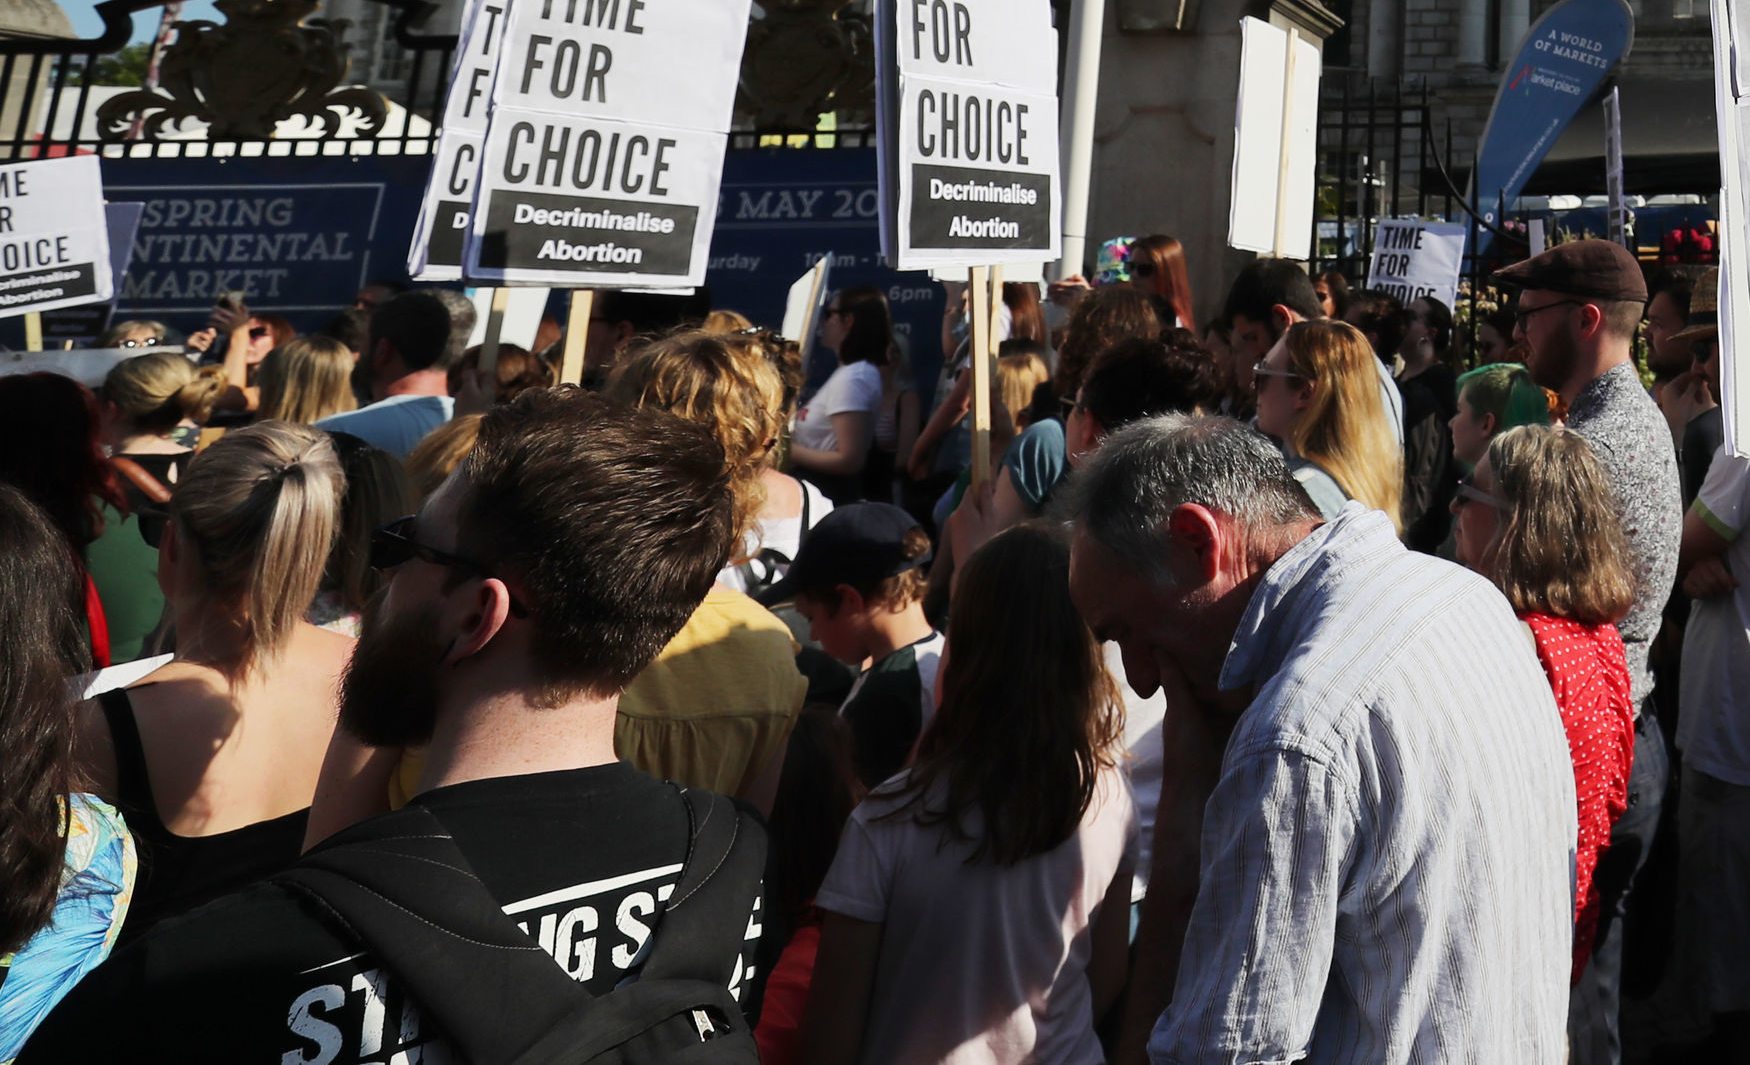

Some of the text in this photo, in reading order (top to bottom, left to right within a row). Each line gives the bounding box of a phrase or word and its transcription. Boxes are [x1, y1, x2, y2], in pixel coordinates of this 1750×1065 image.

[1534, 40, 1608, 70] OF MARKETS
[1548, 29, 1603, 53] A WORLD
[519, 34, 613, 104] FOR
[917, 89, 1029, 166] CHOICE
[503, 122, 677, 197] CHOICE
[735, 190, 823, 220] MAY
[931, 178, 1037, 205] Decriminalise
[142, 199, 294, 228] SPRING
[514, 204, 675, 234] Decriminalise
[948, 215, 1019, 238] Abortion
[537, 239, 643, 264] Abortion
[1382, 225, 1427, 250] TIME
[1375, 253, 1411, 277] FOR
[120, 269, 288, 300] MARKET
[888, 286, 933, 303] 6pm
